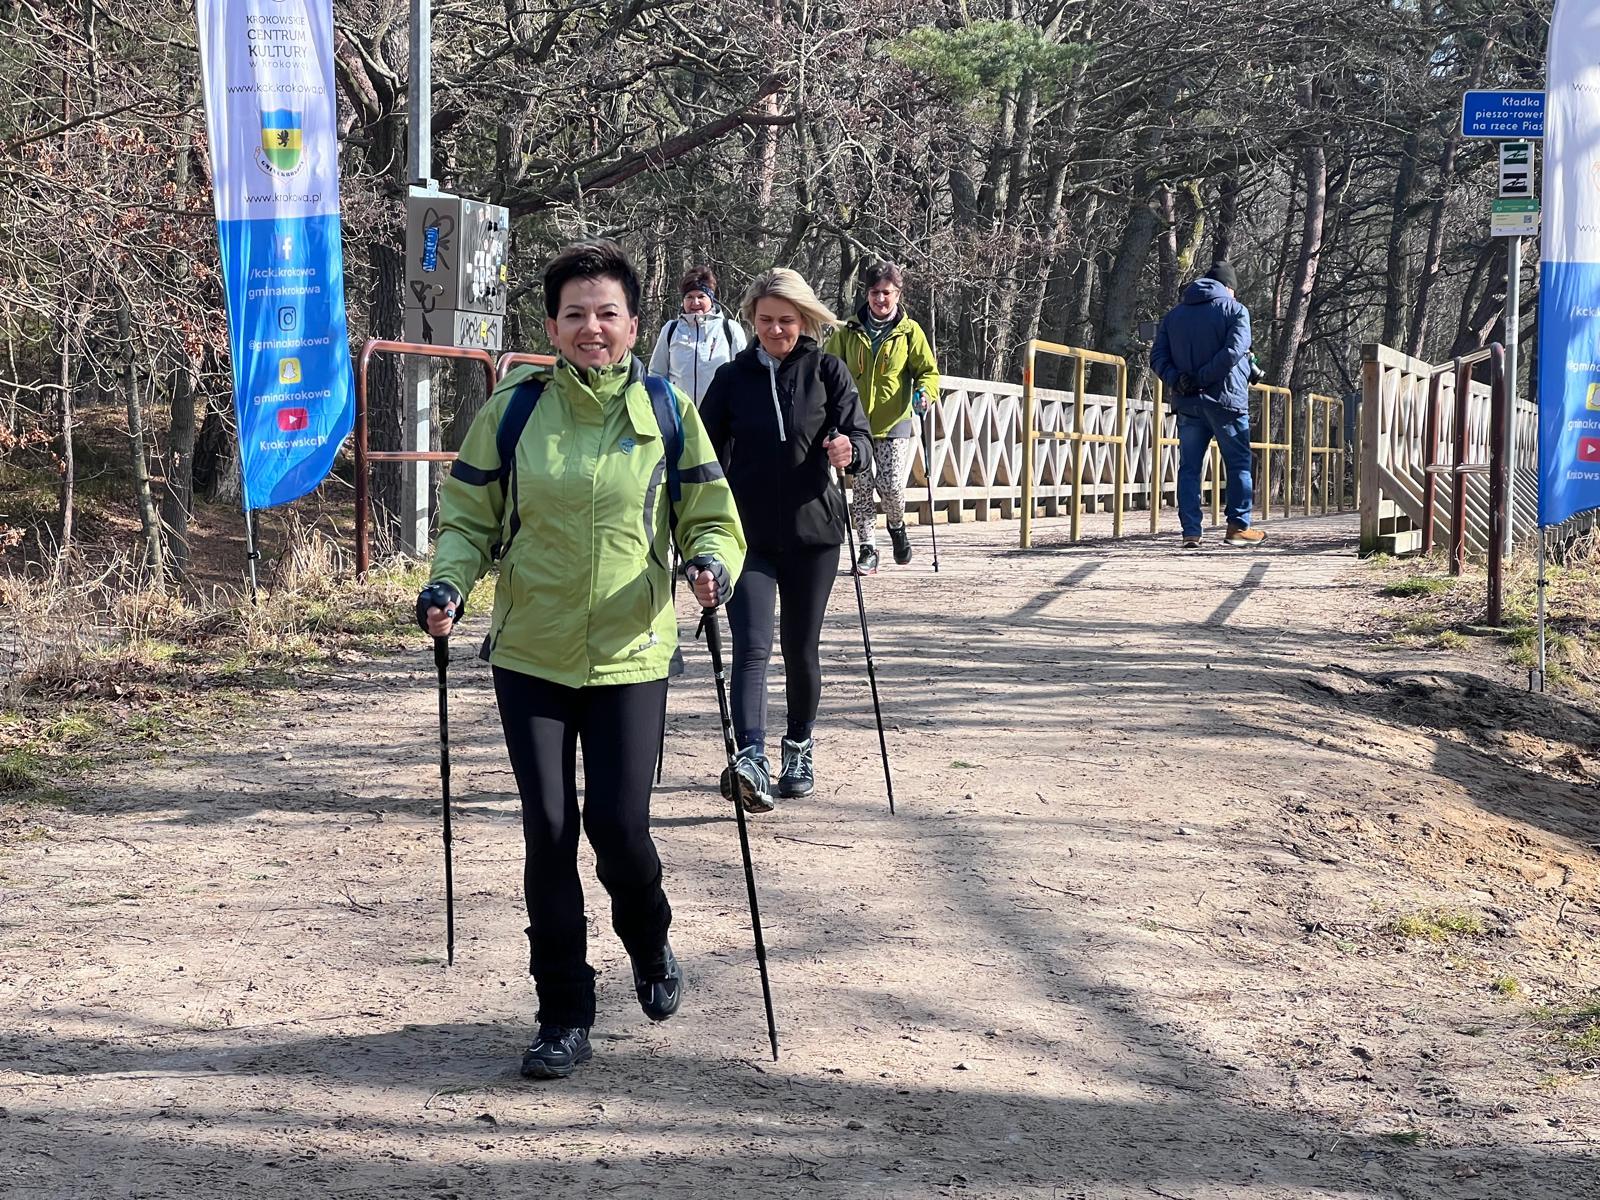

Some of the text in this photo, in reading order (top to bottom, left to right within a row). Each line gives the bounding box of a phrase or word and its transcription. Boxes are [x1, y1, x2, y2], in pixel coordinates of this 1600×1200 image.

[246, 16, 305, 25] KROKOWSKIE
[247, 29, 306, 41] CENTRUM
[248, 45, 307, 58] KULTURY
[227, 82, 326, 96] www.kck.krokowa.pl
[1502, 97, 1540, 107] Kładka
[244, 192, 322, 203] www.krokowa.pl
[248, 284, 321, 300] gminakrokowa
[253, 389, 331, 405] gminakrokowa
